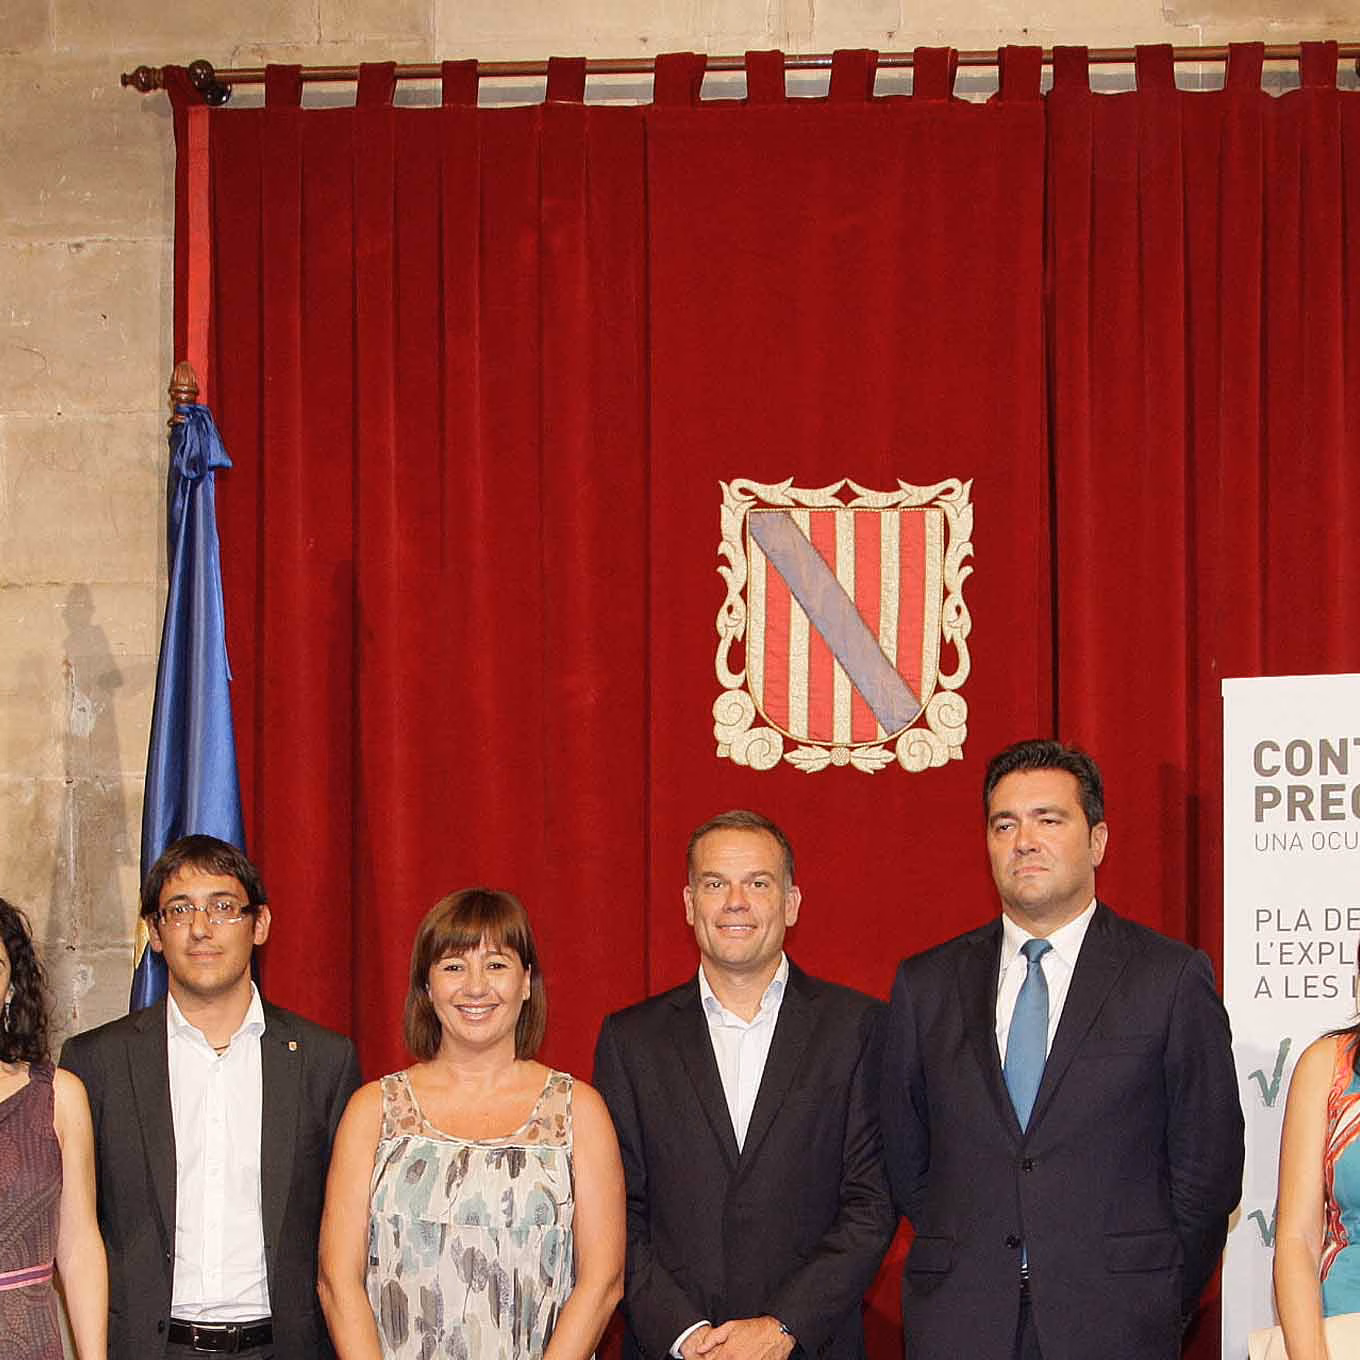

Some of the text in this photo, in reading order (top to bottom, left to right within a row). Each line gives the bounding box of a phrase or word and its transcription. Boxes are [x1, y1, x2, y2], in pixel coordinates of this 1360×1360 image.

[1255, 832, 1304, 851] UNA
[1256, 908, 1312, 932] PLA
[1256, 941, 1354, 965] L'EXPL
[1254, 975, 1272, 999] A
[1285, 975, 1338, 998] LES
